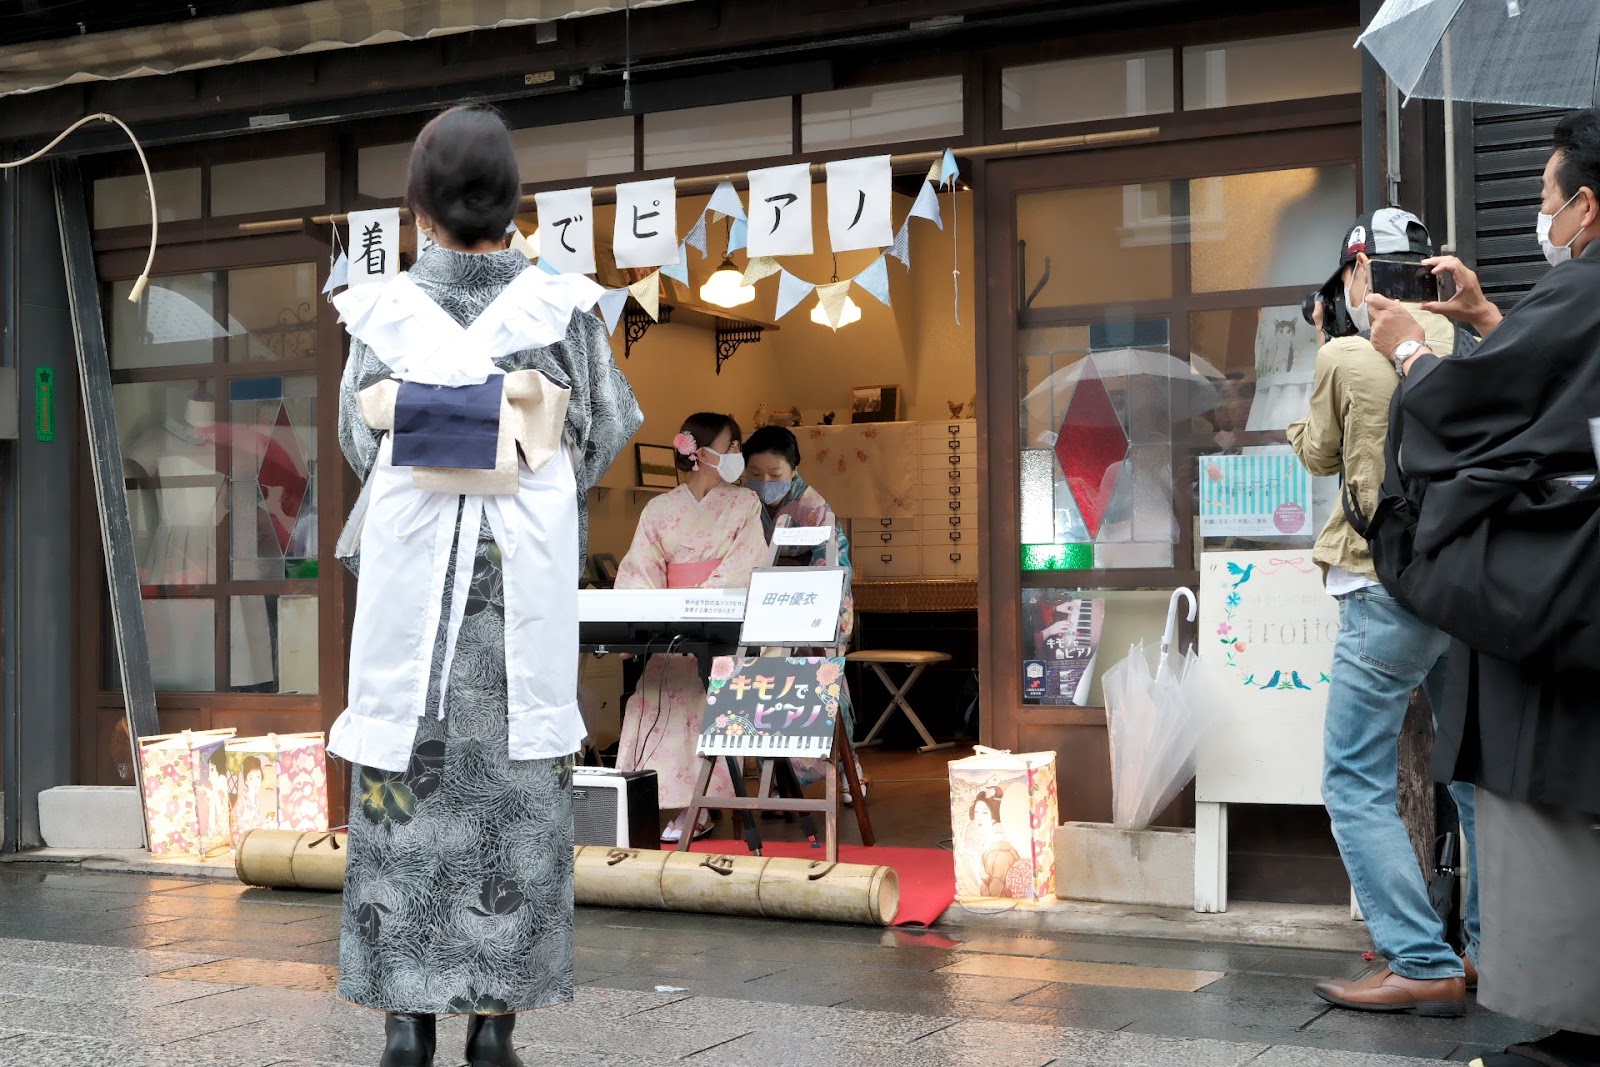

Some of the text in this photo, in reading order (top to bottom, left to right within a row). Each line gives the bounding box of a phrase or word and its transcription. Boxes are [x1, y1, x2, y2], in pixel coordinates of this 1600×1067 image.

[762, 591, 818, 606] 田中優衣
[811, 618, 822, 628] 様
[1046, 638, 1079, 649] キモノで
[1065, 647, 1091, 659] ピアノ
[729, 674, 809, 700] キモノで
[754, 702, 821, 729] ピアノ
